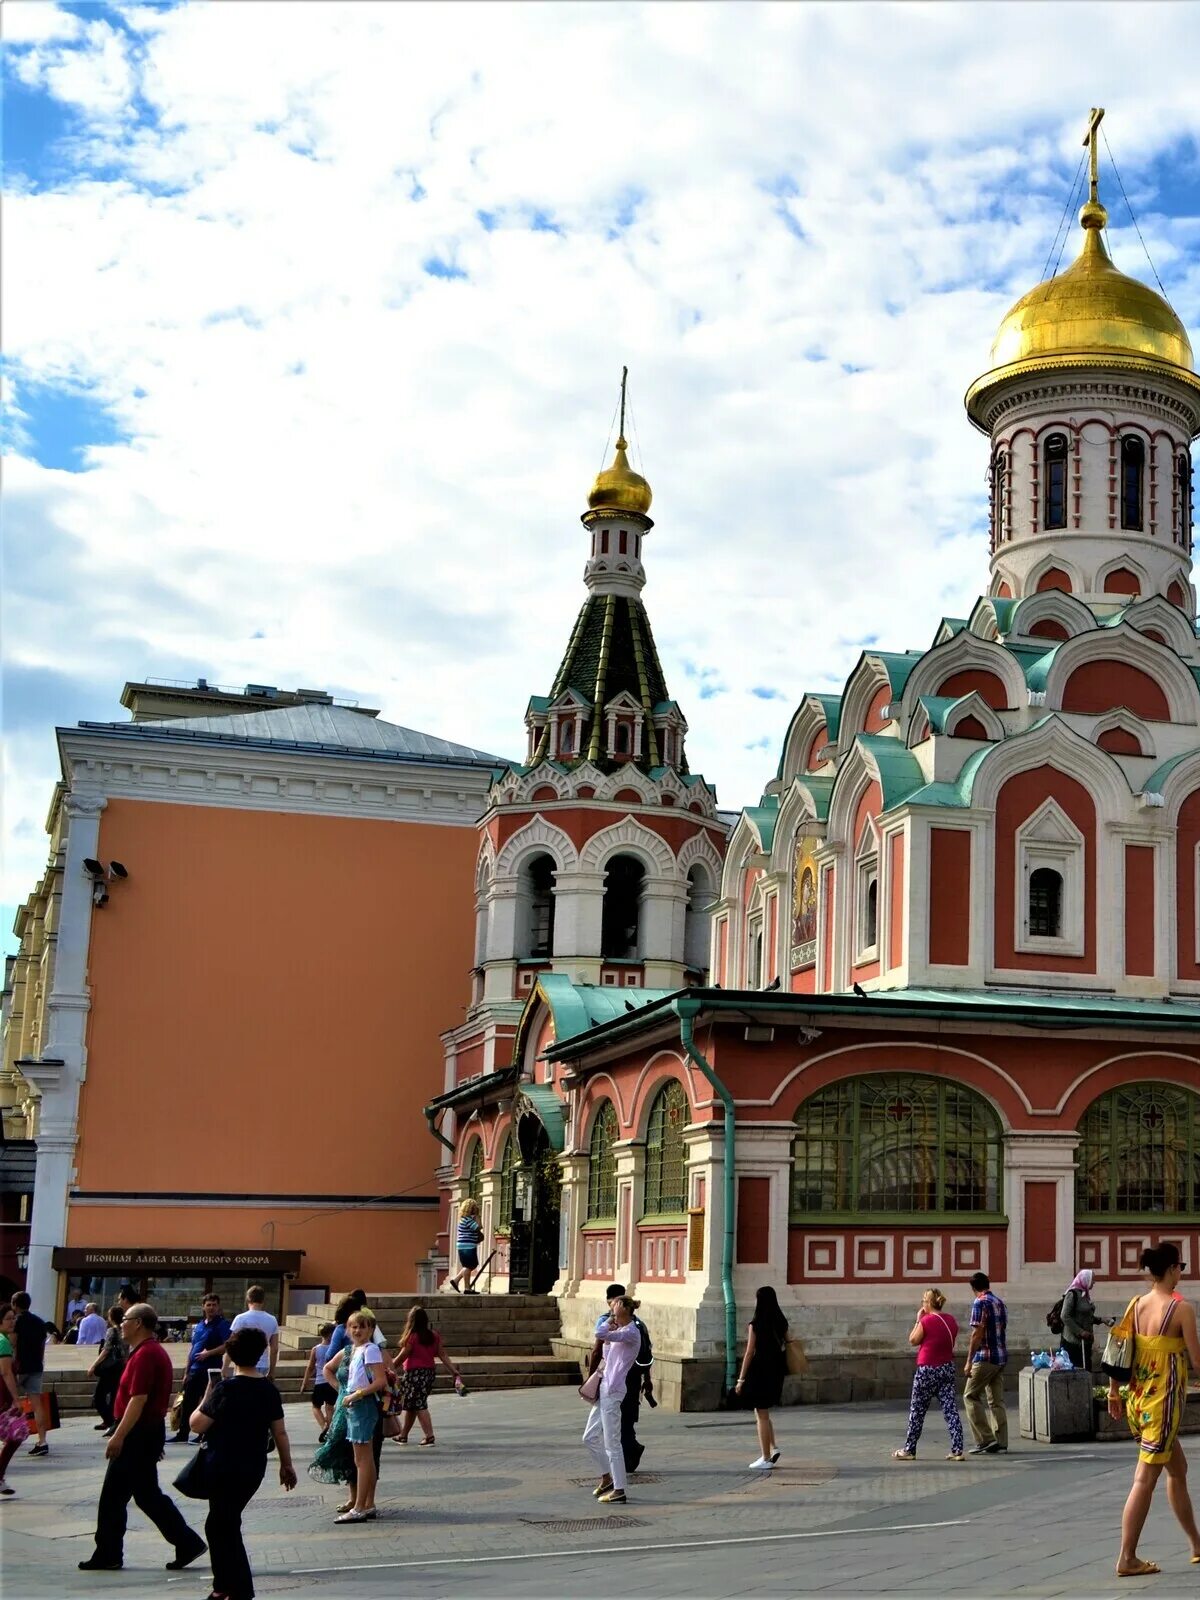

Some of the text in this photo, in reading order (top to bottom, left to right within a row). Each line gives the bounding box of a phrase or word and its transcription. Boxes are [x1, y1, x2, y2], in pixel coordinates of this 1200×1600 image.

[85, 1254, 270, 1265] ИКОННАЯ ЛАВКА КАЗАНСКОГО СОБОРА
